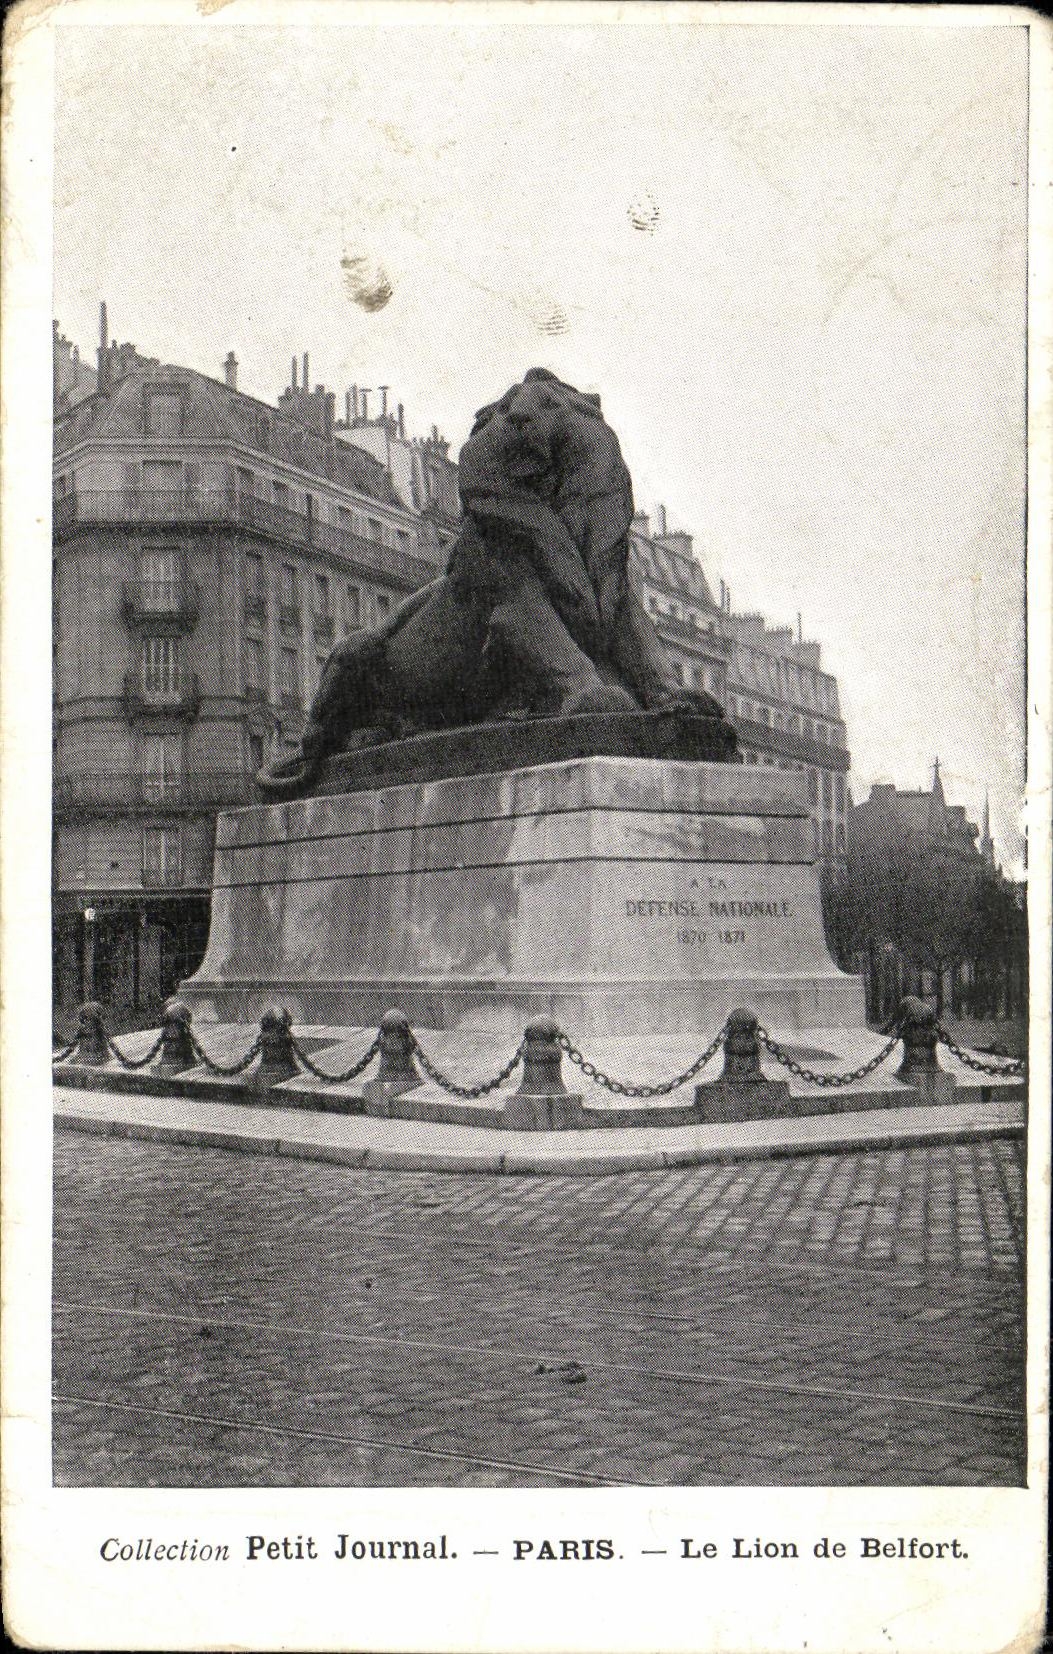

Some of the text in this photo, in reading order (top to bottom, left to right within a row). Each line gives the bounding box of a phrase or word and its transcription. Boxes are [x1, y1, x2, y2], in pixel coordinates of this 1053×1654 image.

[626, 900, 700, 917] DEFENSE
[678, 930, 746, 945] 1870 1871
